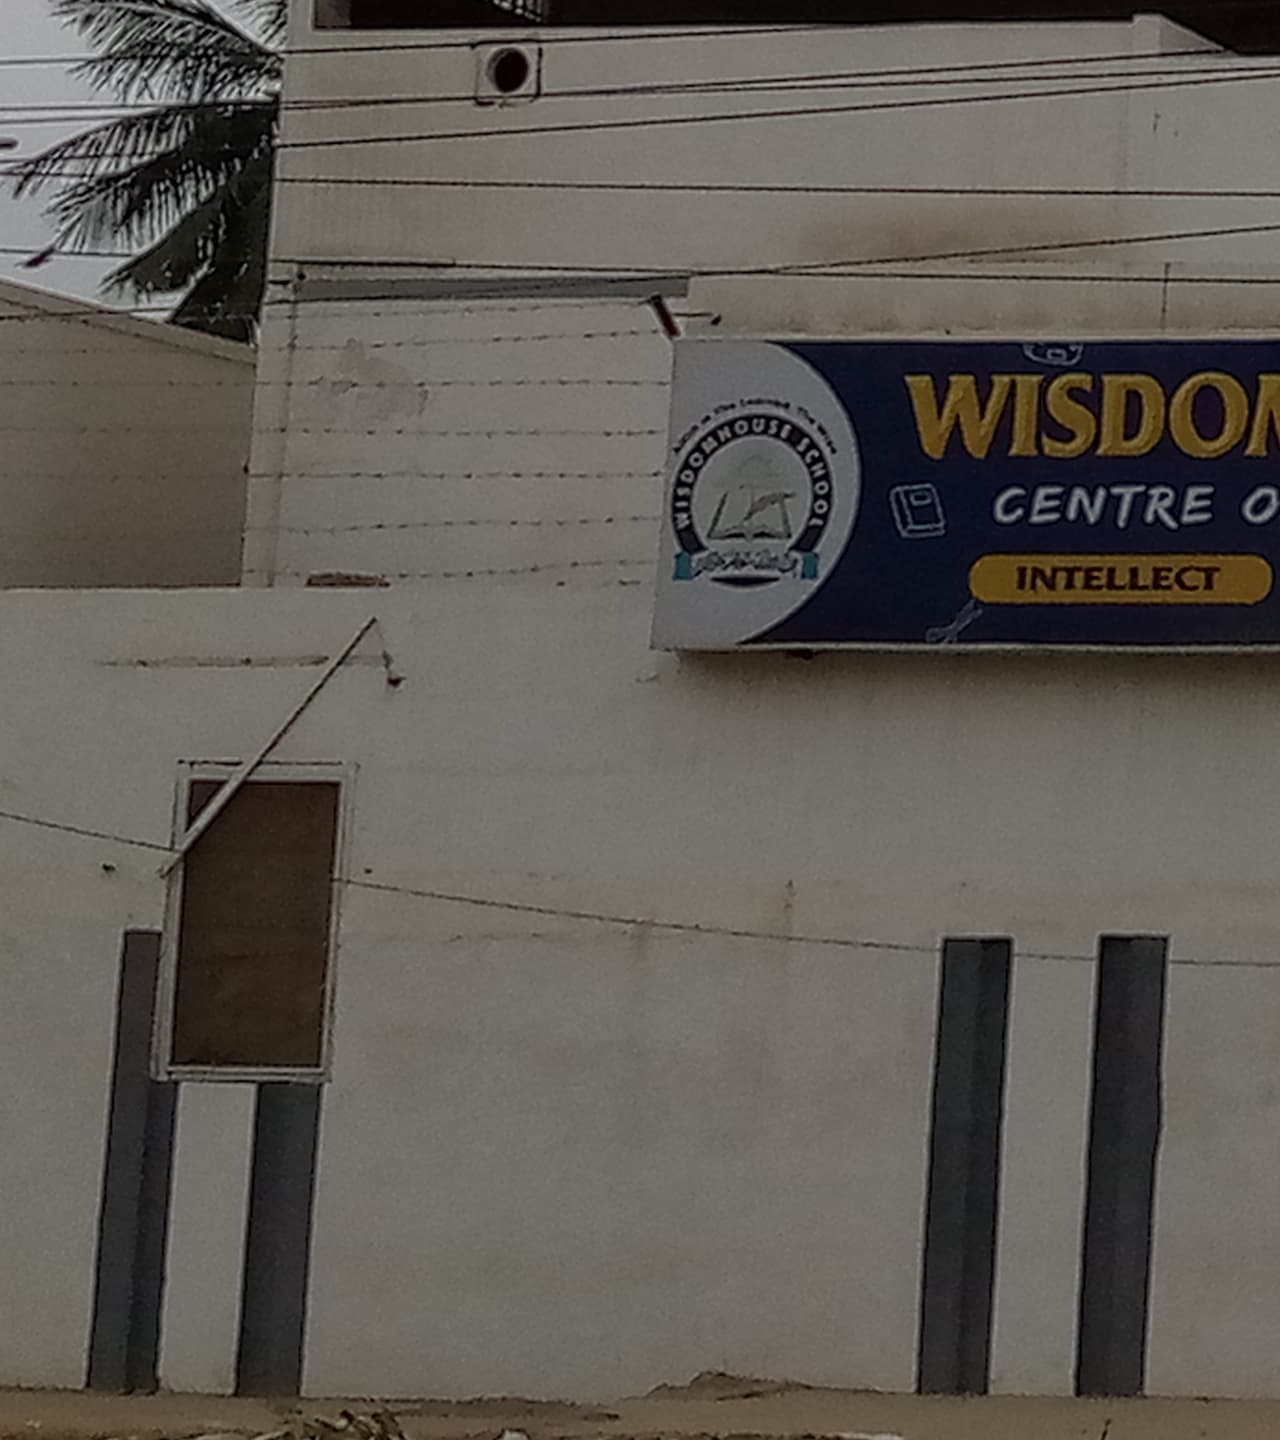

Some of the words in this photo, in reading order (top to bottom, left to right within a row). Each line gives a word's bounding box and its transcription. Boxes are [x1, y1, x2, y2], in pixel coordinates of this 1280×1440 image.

[674, 417, 793, 531] WISDOMHOUSE
[797, 436, 830, 527] SCHOOL
[992, 482, 1216, 530] CENTRE
[1015, 563, 1221, 593] INTELLECT
